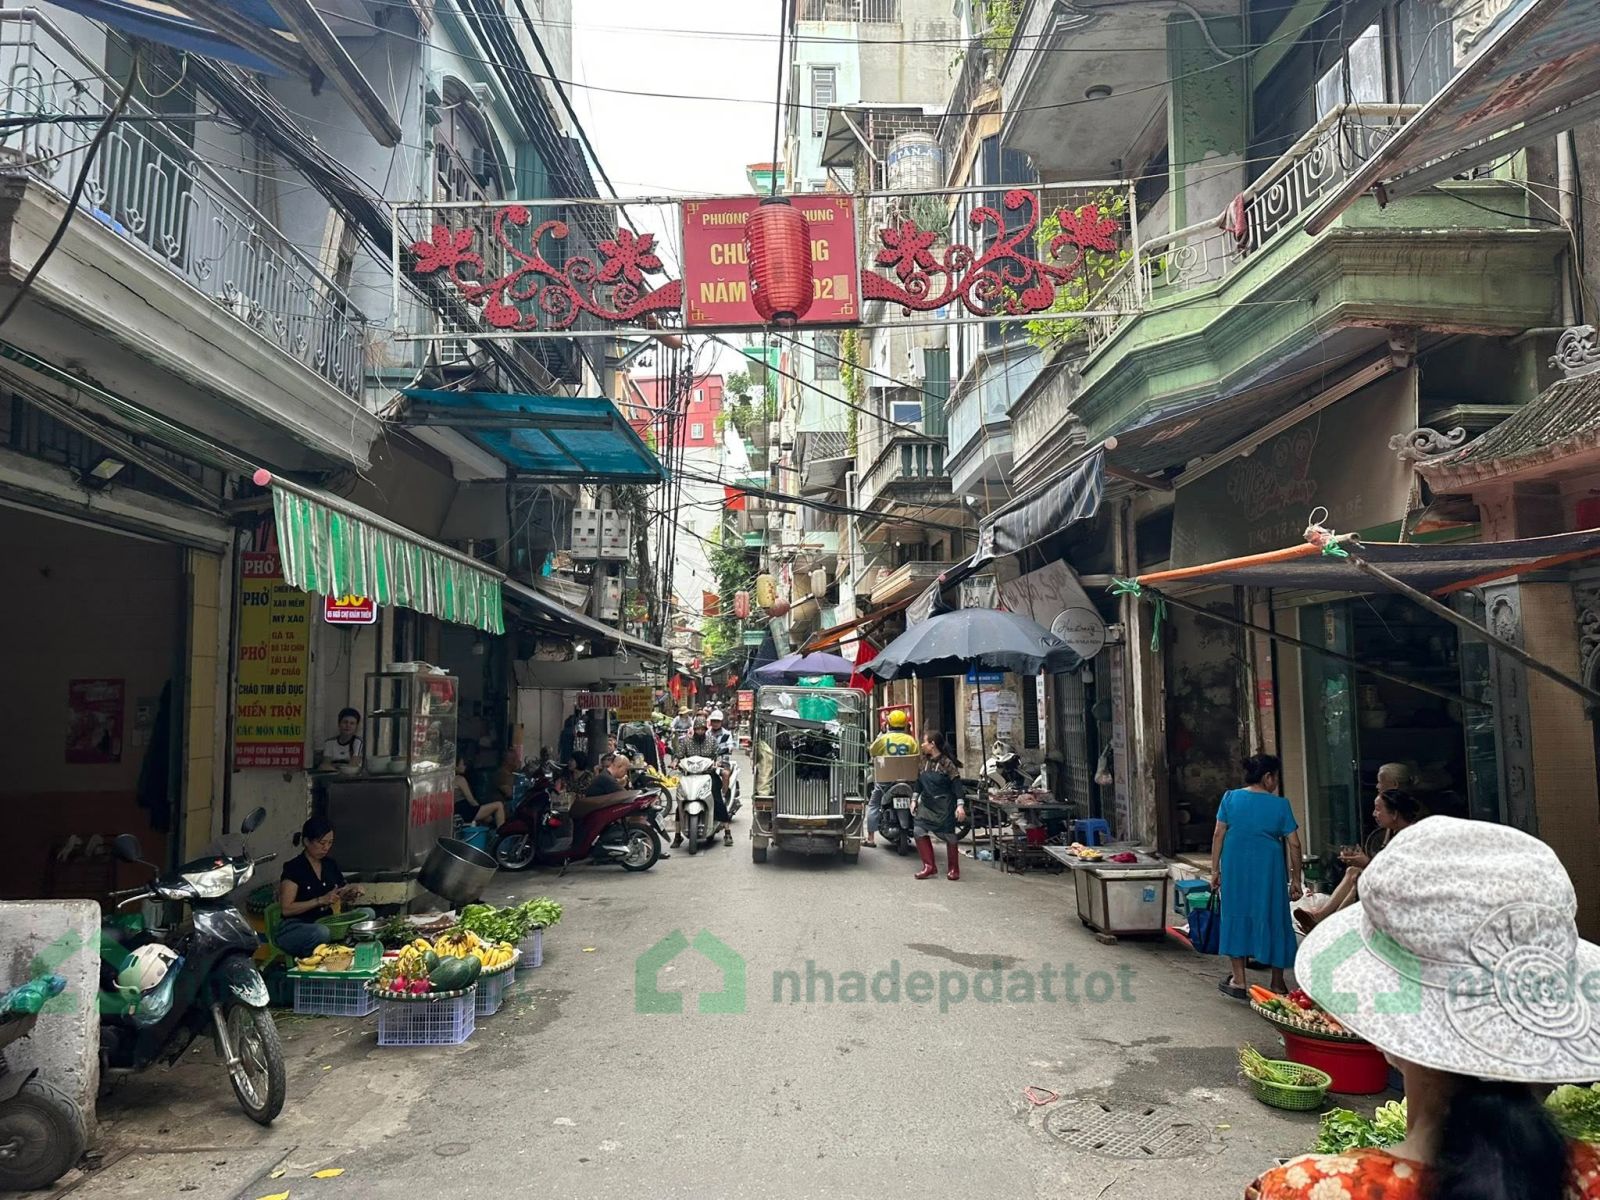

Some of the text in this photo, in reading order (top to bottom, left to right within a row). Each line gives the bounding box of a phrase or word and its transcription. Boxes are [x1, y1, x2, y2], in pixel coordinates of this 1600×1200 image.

[700, 277, 746, 304] NĂM
[244, 555, 275, 575] PHỞ
[243, 586, 270, 606] PHỞ
[241, 640, 268, 661] PHỞ
[260, 684, 274, 695] TIM
[270, 702, 302, 721] TRỘN
[886, 738, 910, 756] be
